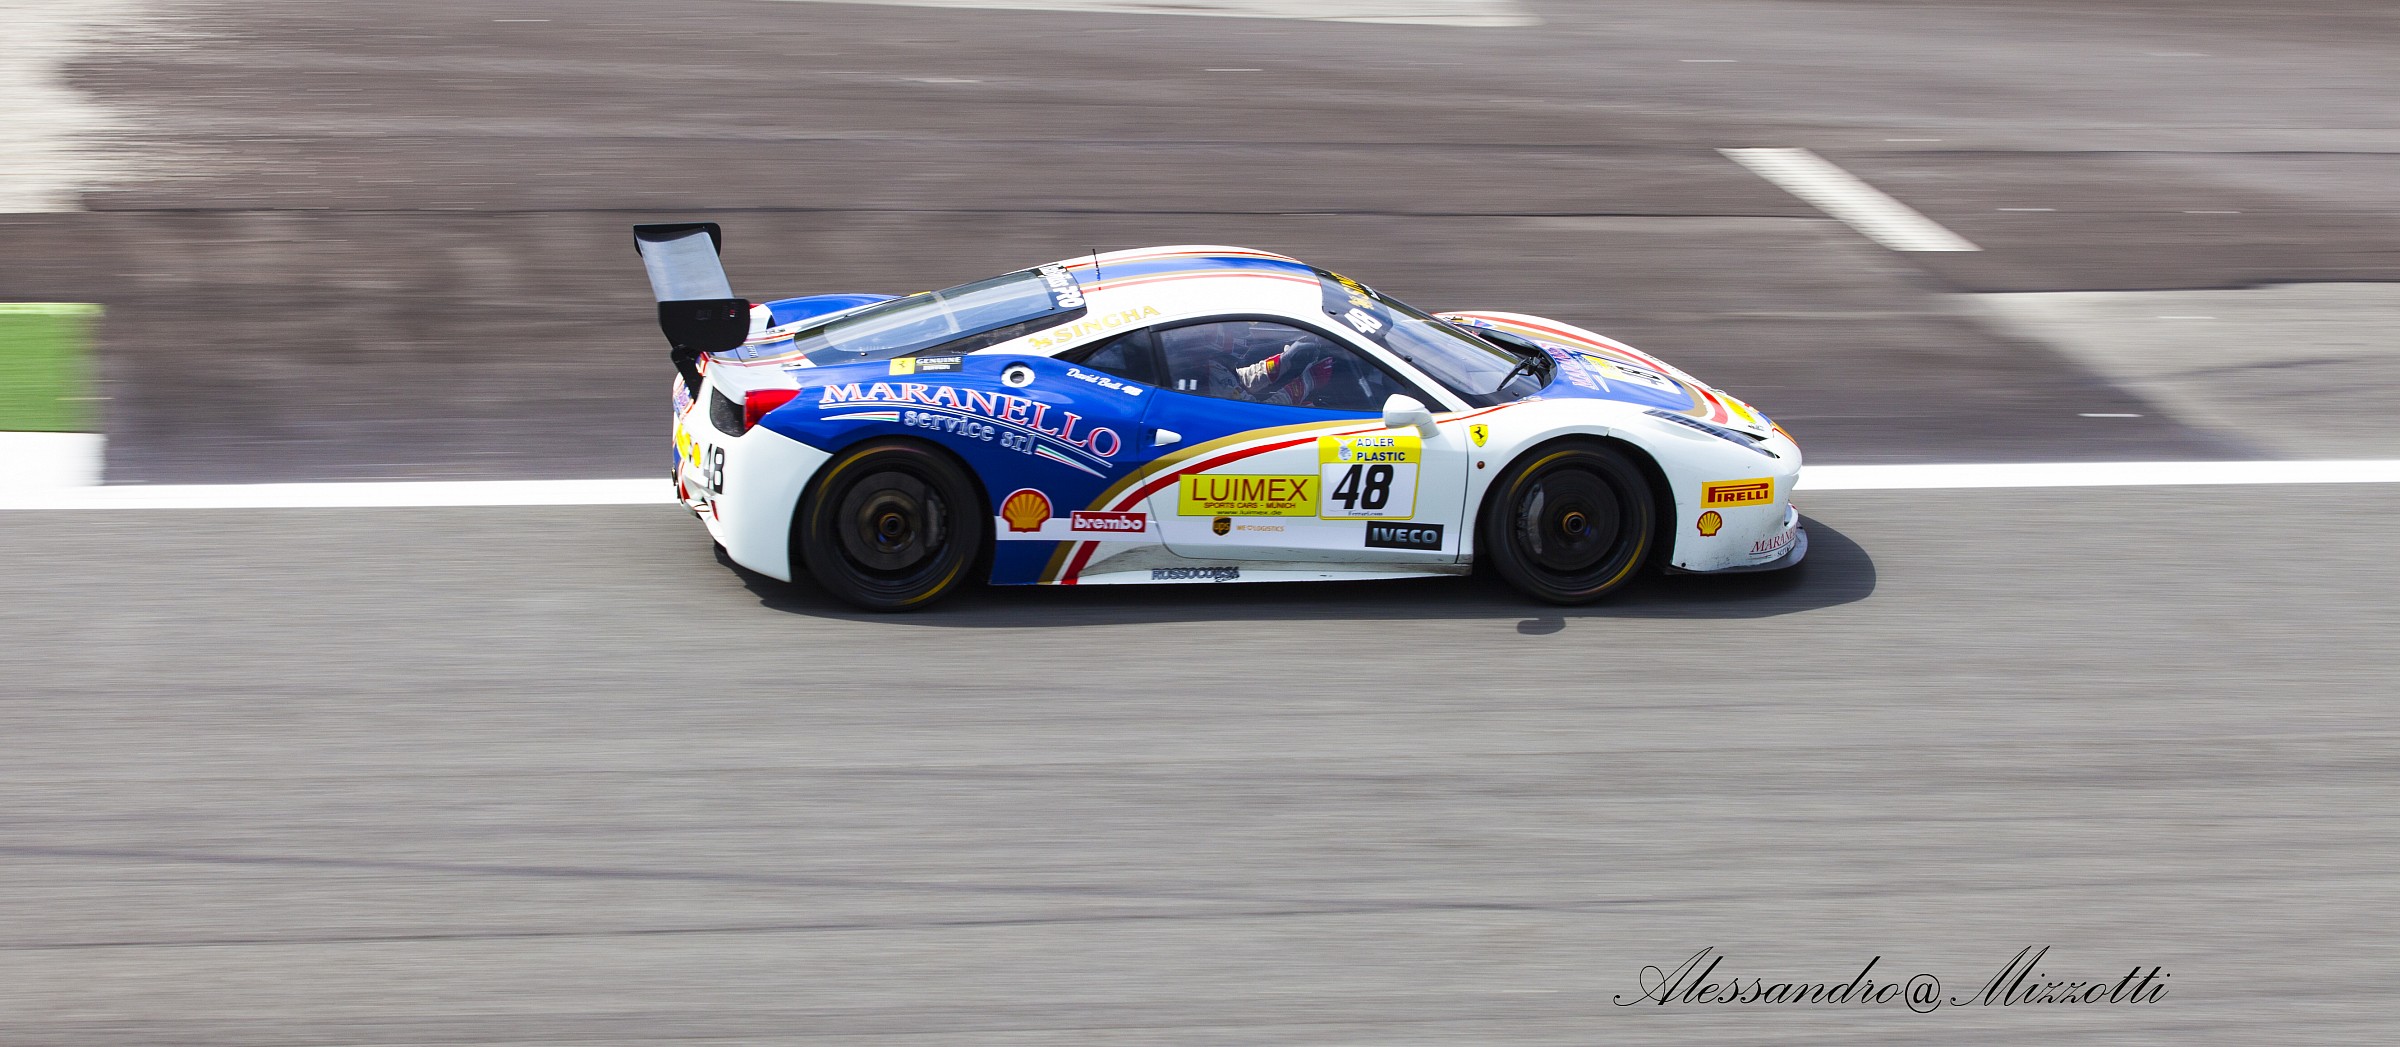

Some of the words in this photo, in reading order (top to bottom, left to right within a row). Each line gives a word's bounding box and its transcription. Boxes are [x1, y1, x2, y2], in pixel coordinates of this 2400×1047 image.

[1053, 305, 1161, 344] SINGHA
[1344, 308, 1383, 334] 48
[1066, 368, 1100, 383] David
[819, 382, 1122, 457] MARANELLO
[904, 410, 994, 442] service
[1000, 430, 1036, 455] srl
[1357, 438, 1394, 447] ADLER
[703, 443, 725, 494] 48
[1357, 452, 1406, 461] PLASTIC
[1192, 478, 1308, 502] LUIMEX
[1331, 464, 1394, 510] 48
[1708, 483, 1769, 503] PIRELLI
[1074, 514, 1143, 530] brembo
[1372, 528, 1438, 543] IVECO
